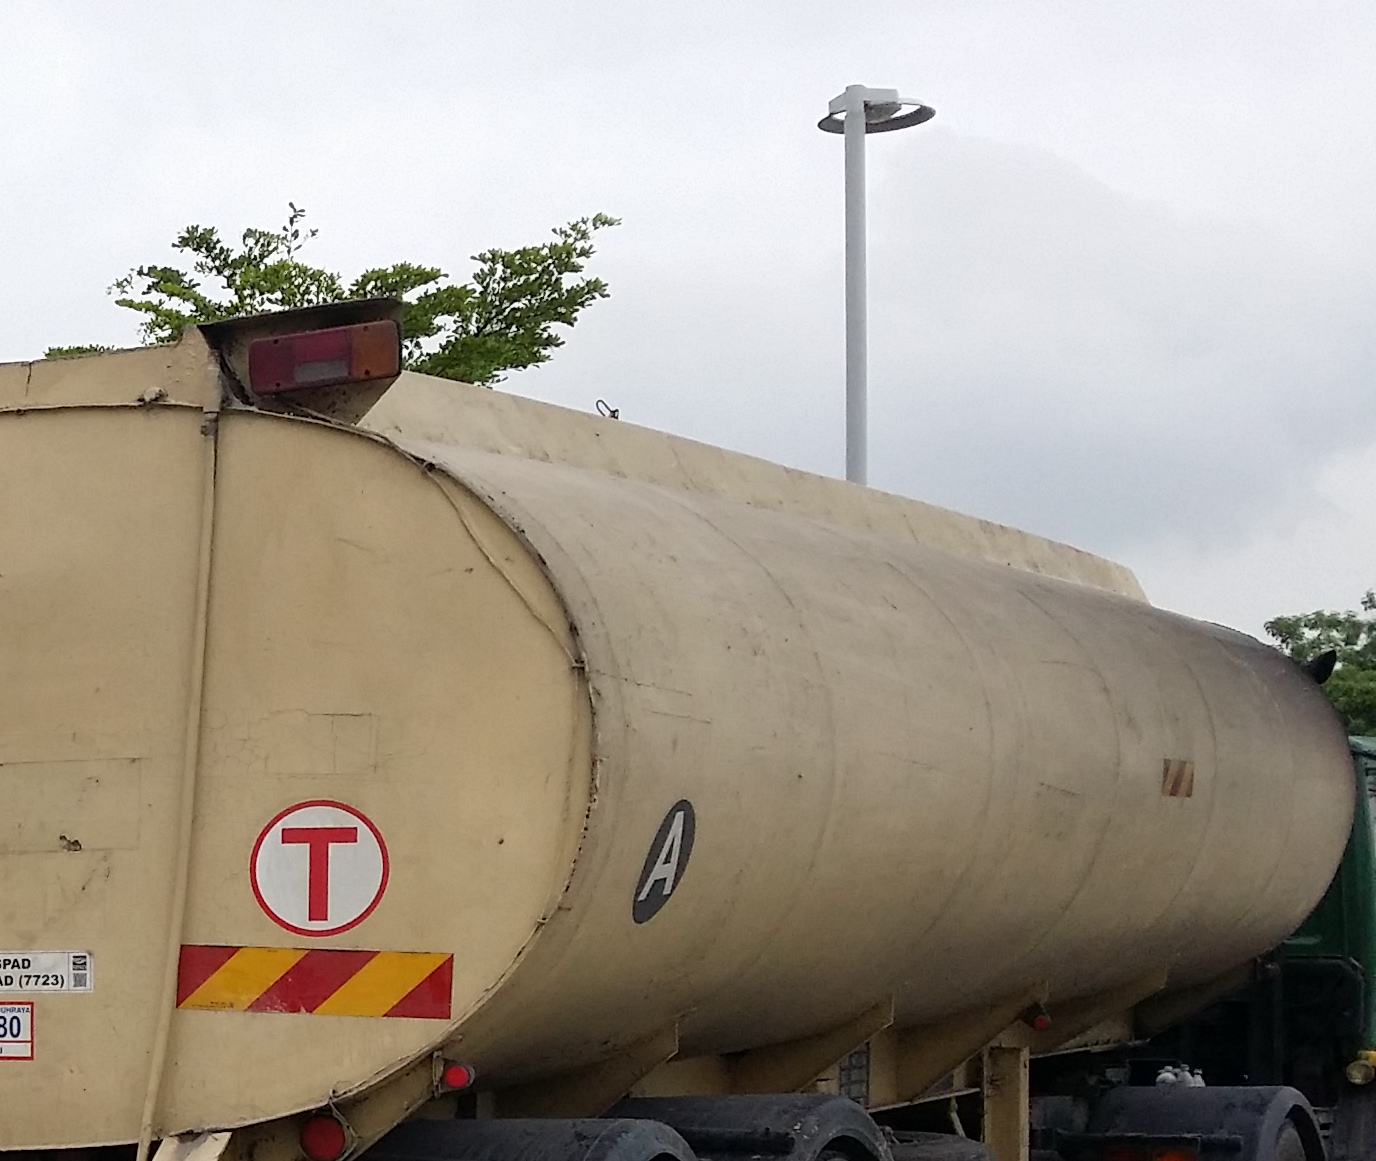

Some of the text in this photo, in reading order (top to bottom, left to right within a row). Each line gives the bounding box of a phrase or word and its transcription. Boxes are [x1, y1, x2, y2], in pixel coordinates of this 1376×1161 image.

[281, 827, 358, 922] T
[637, 810, 685, 901] A
[18, 974, 65, 988] (7723)
